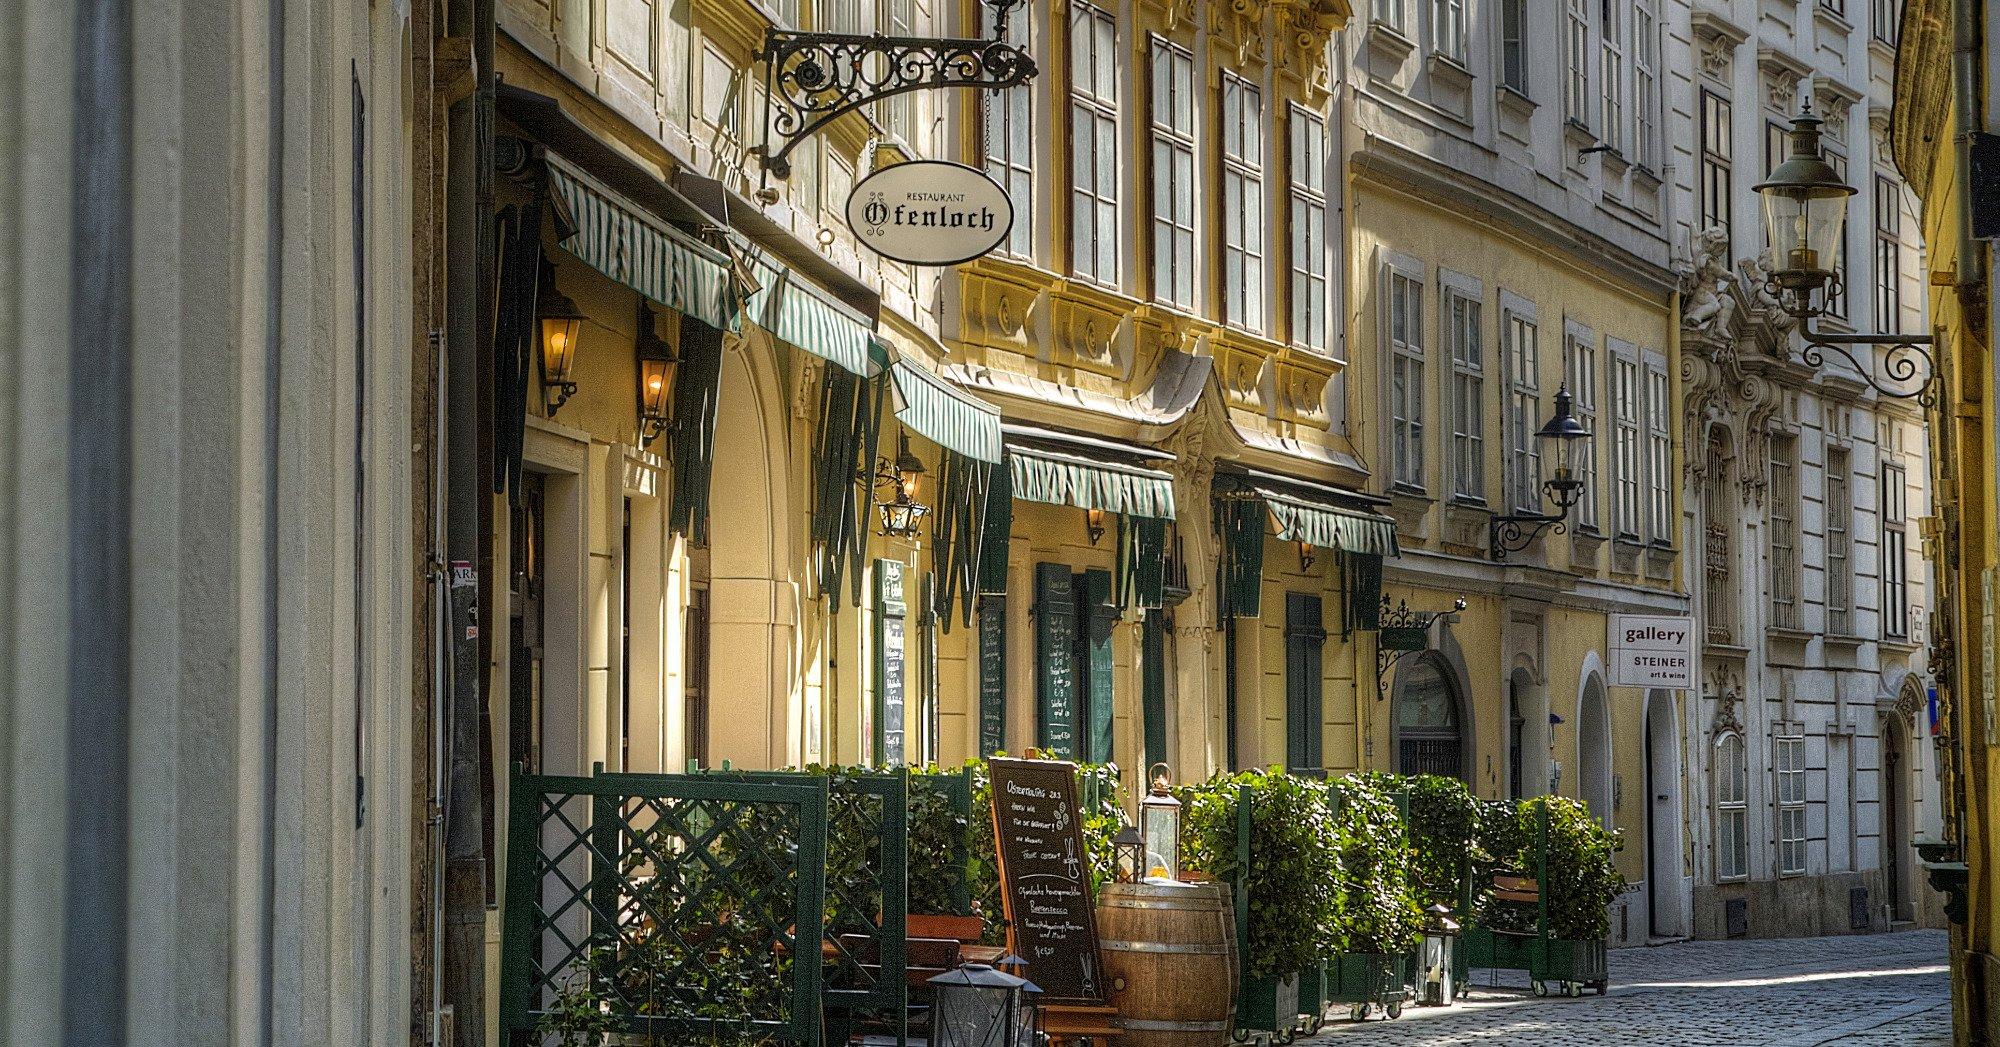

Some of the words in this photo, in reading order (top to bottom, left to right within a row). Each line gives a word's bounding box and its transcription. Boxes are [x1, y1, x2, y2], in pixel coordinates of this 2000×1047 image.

[906, 192, 965, 202] RESTAURANT
[862, 198, 995, 233] Ofenloch
[1626, 627, 1685, 644] gallery
[1634, 656, 1686, 668] STEINER
